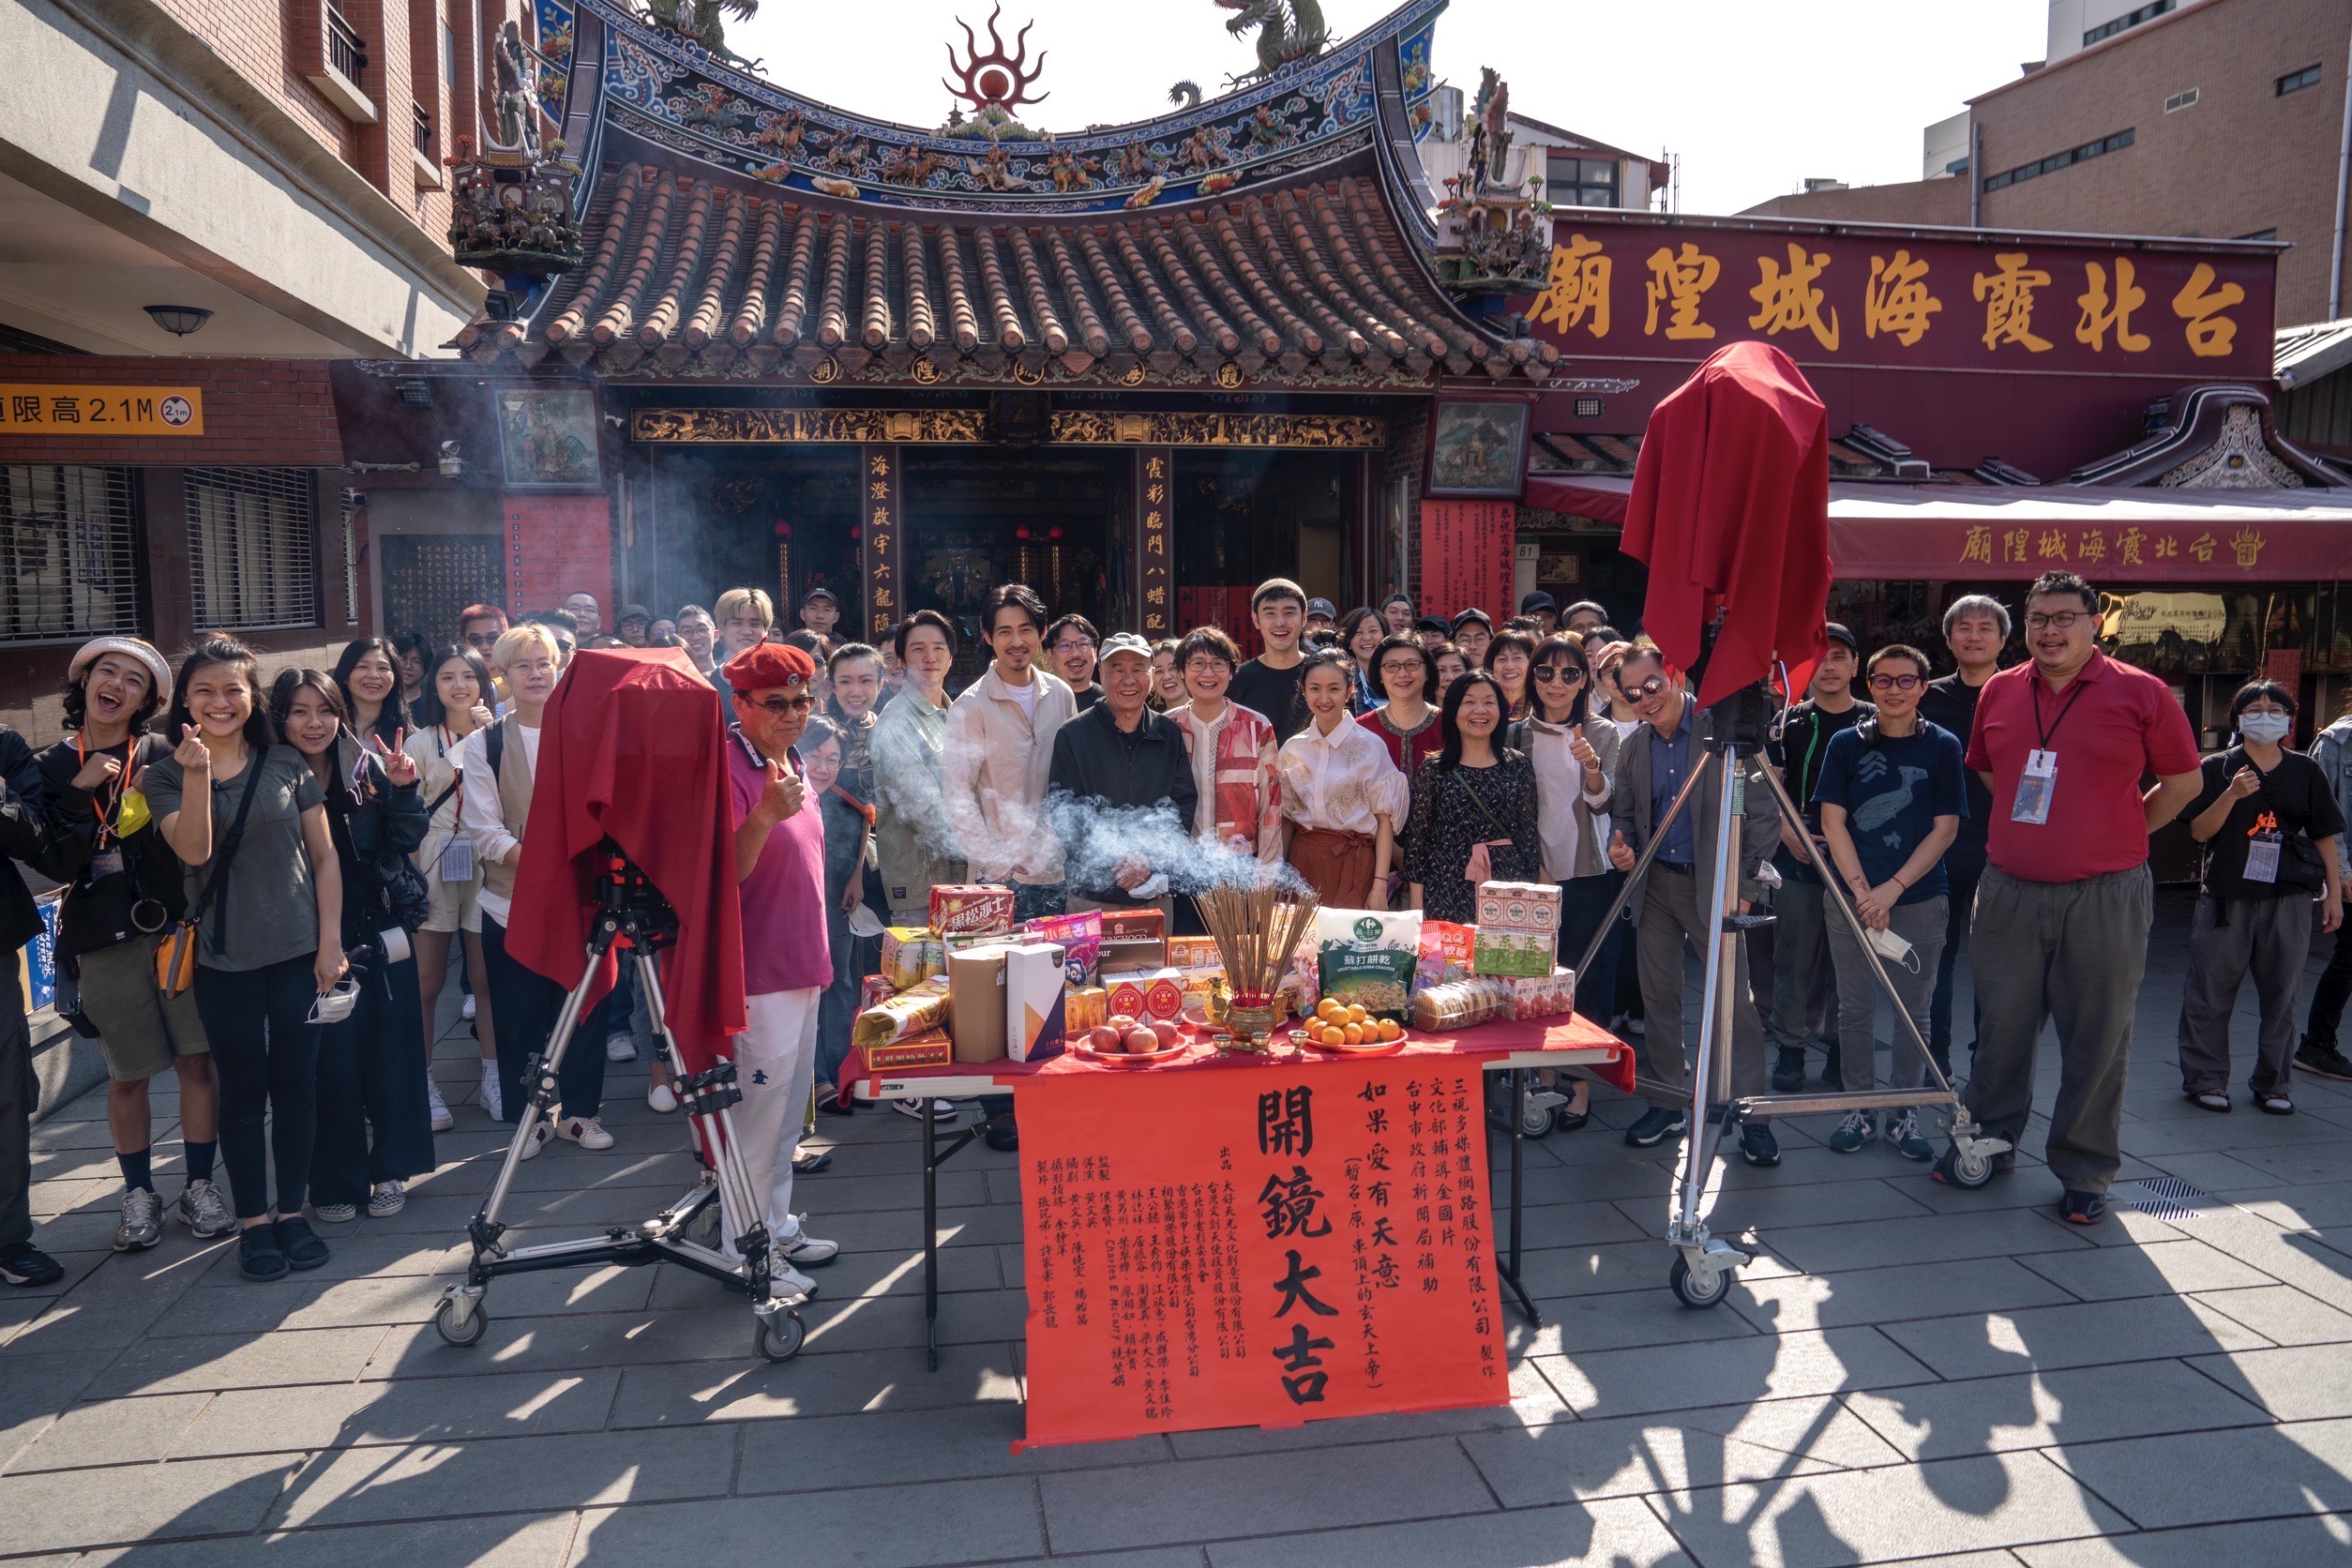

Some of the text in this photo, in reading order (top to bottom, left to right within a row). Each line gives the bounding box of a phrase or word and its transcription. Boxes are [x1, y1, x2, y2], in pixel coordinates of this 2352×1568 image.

[0, 396, 153, 423] 限高2.1M
[165, 405, 188, 416] 2.1m
[1520, 546, 1531, 557] 61
[1959, 526, 2218, 565] 台北霞海城隍廟
[1344, 955, 1391, 965] 蘇打餅乾
[1037, 1160, 1048, 1185] 製片
[1083, 1156, 1095, 1180] 導演
[1220, 1147, 1231, 1170] 出品
[1429, 1078, 1455, 1245] 文化部輔導金國片
[1357, 1081, 1399, 1292] 如果愛有天意
[1406, 1080, 1438, 1293] 台中市政府新聞局補助
[1098, 1156, 1110, 1181] 監製
[1105, 1239, 1117, 1280] Charles
[1259, 1086, 1337, 1405] 開鏡大吉
[1481, 1345, 1495, 1378] 製作
